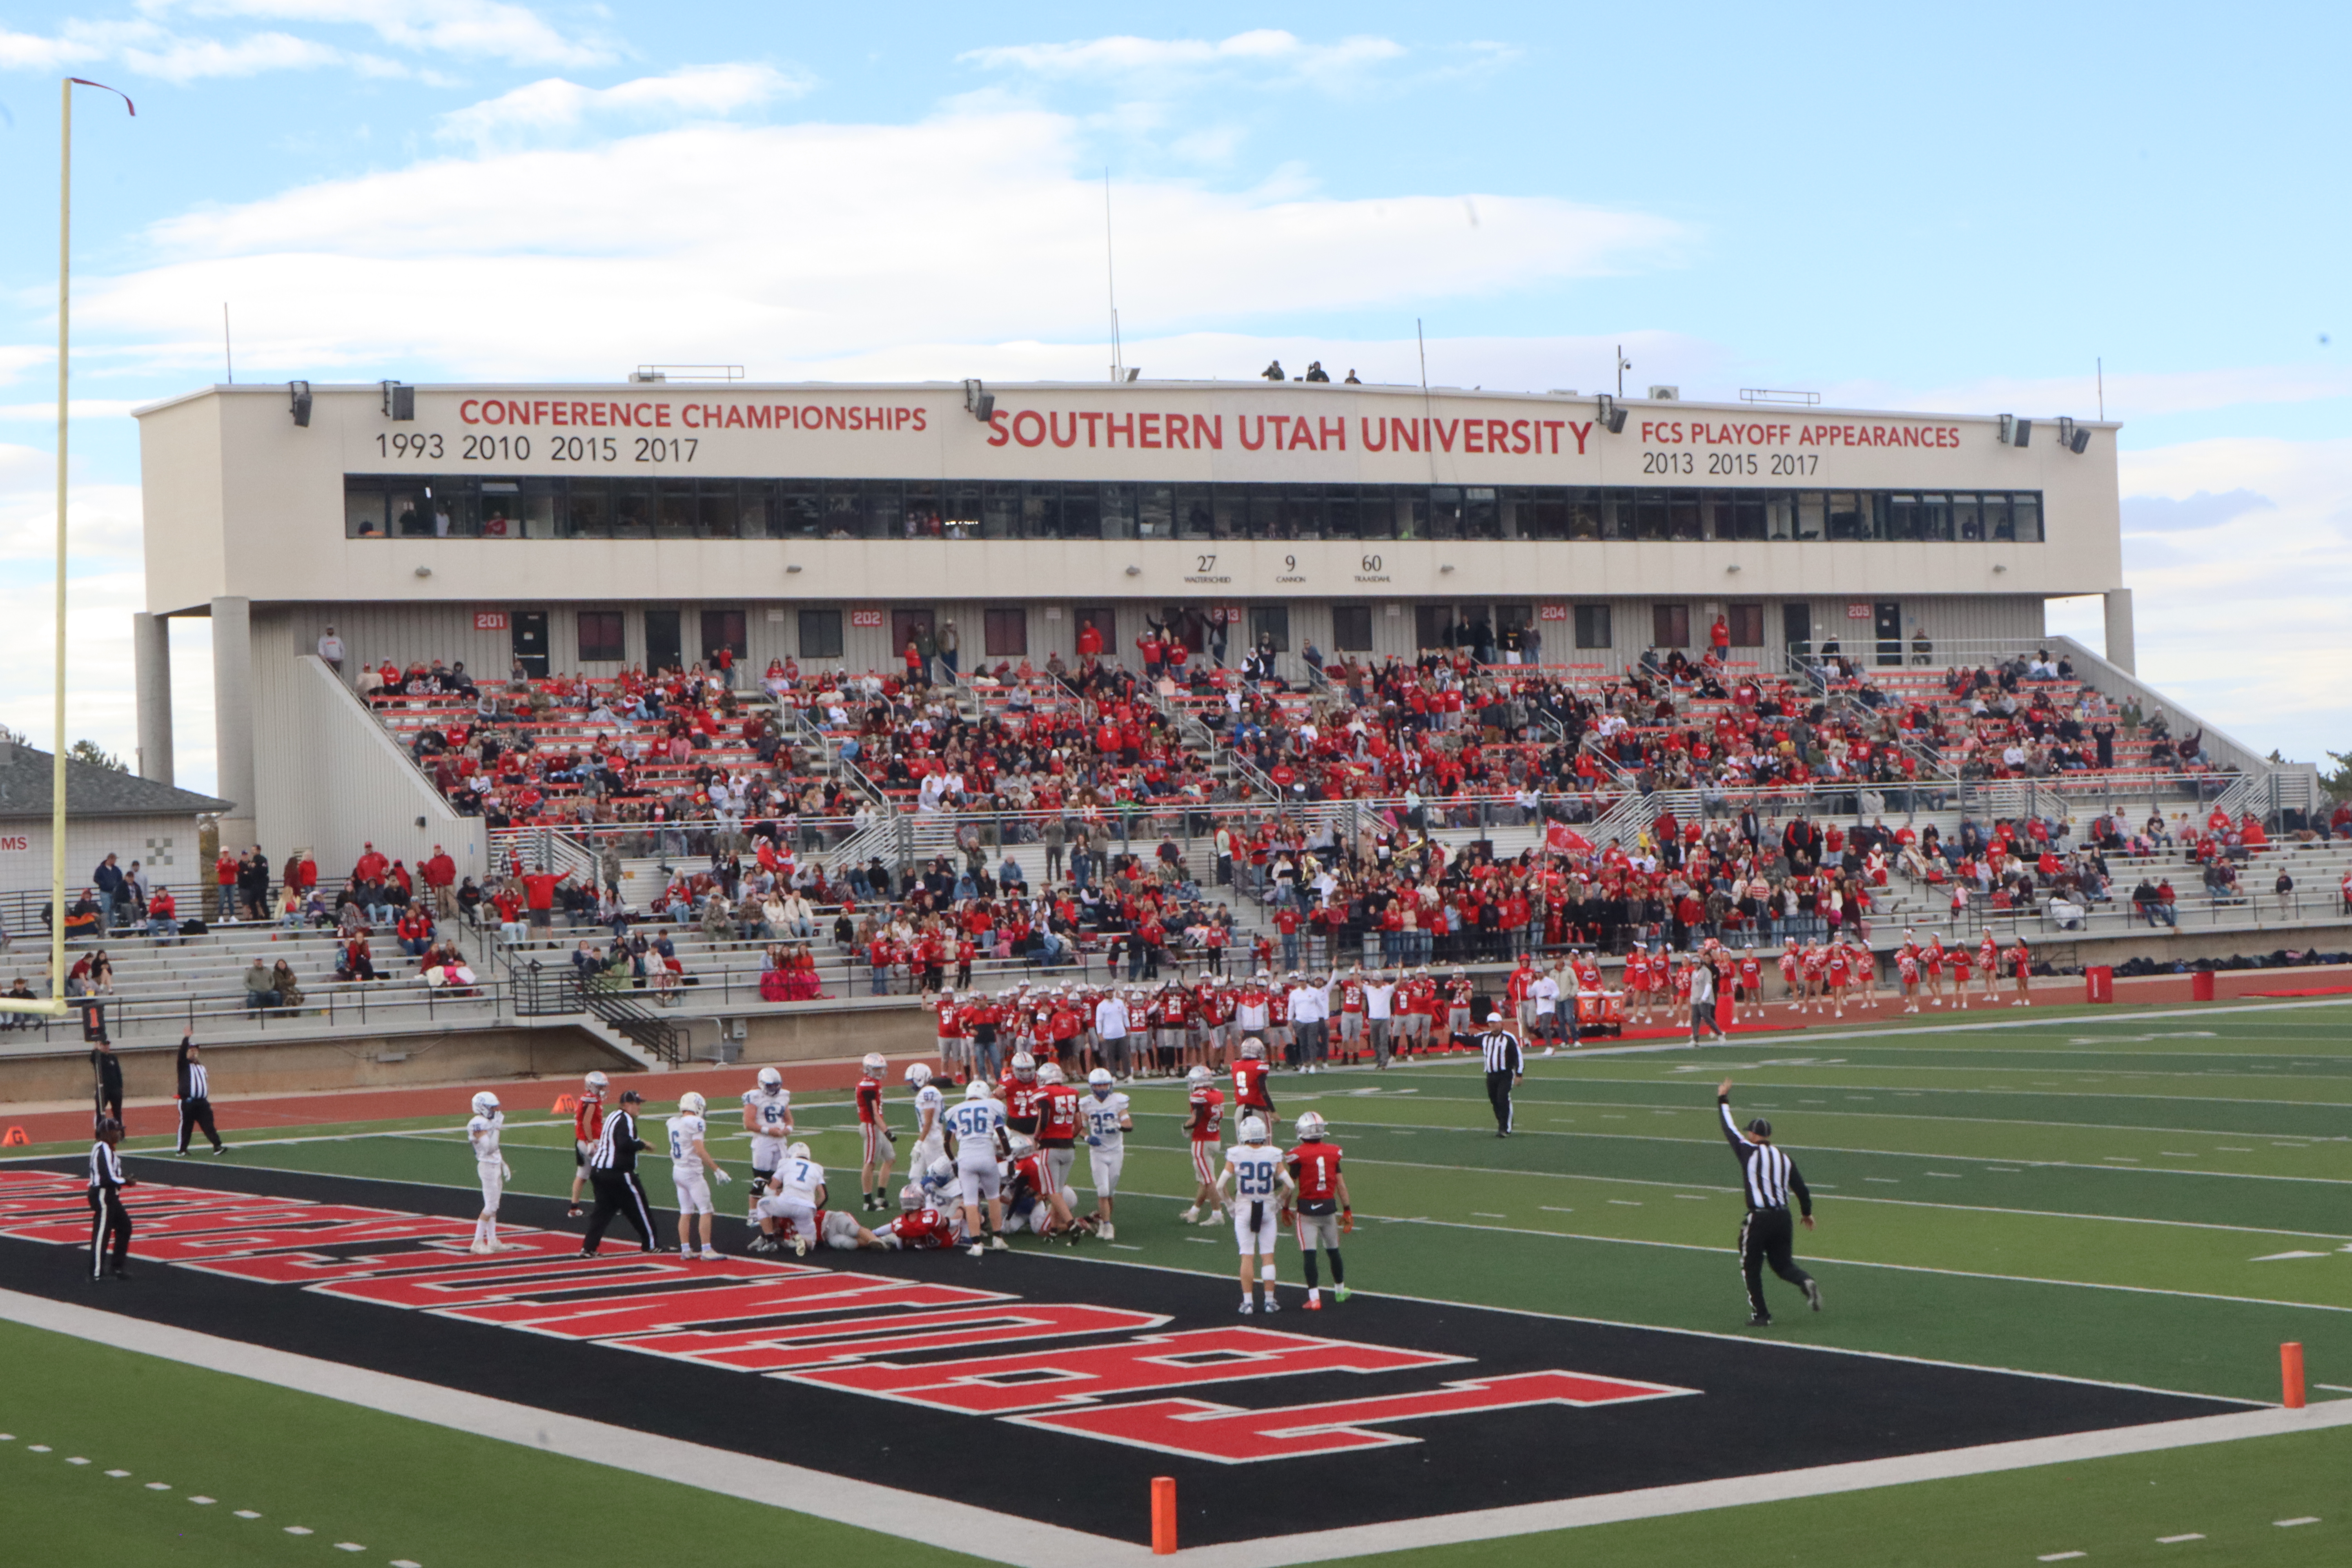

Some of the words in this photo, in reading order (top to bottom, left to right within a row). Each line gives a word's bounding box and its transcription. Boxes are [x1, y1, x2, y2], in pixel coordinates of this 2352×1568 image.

[461, 399, 671, 427] CONFERENCE
[682, 404, 926, 431] CHAMPIONSHIPS
[987, 410, 1222, 449] SOUTHERN
[1239, 415, 1346, 450] UTAH
[1362, 417, 1593, 455] UNIVERSITY
[1642, 422, 1682, 443] FCS
[1691, 423, 1790, 445] PLAYOFF
[1799, 425, 1959, 448] APPEARANCES
[377, 432, 444, 459] 1993
[463, 434, 531, 461] 2010
[551, 436, 617, 462] 2015
[635, 437, 698, 463] 2017
[1643, 452, 1693, 474] 2013
[1708, 453, 1758, 475] 2015
[1771, 454, 1818, 475] 2017
[1197, 555, 1216, 572] 27
[1285, 555, 1296, 572] 9
[1362, 555, 1382, 572] 60
[477, 614, 505, 630] 201
[855, 612, 880, 626] 202
[1542, 606, 1565, 621] 204
[1849, 605, 1870, 618] 205
[89, 1007, 100, 1028] 1
[562, 1098, 574, 1112] 10
[1053, 1094, 1077, 1125] 55
[958, 1106, 988, 1136] 56
[12, 1130, 24, 1144] G
[671, 1130, 682, 1159] 6
[796, 1161, 809, 1183] 7
[1239, 1161, 1273, 1194] 29
[1316, 1156, 1327, 1191] 1
